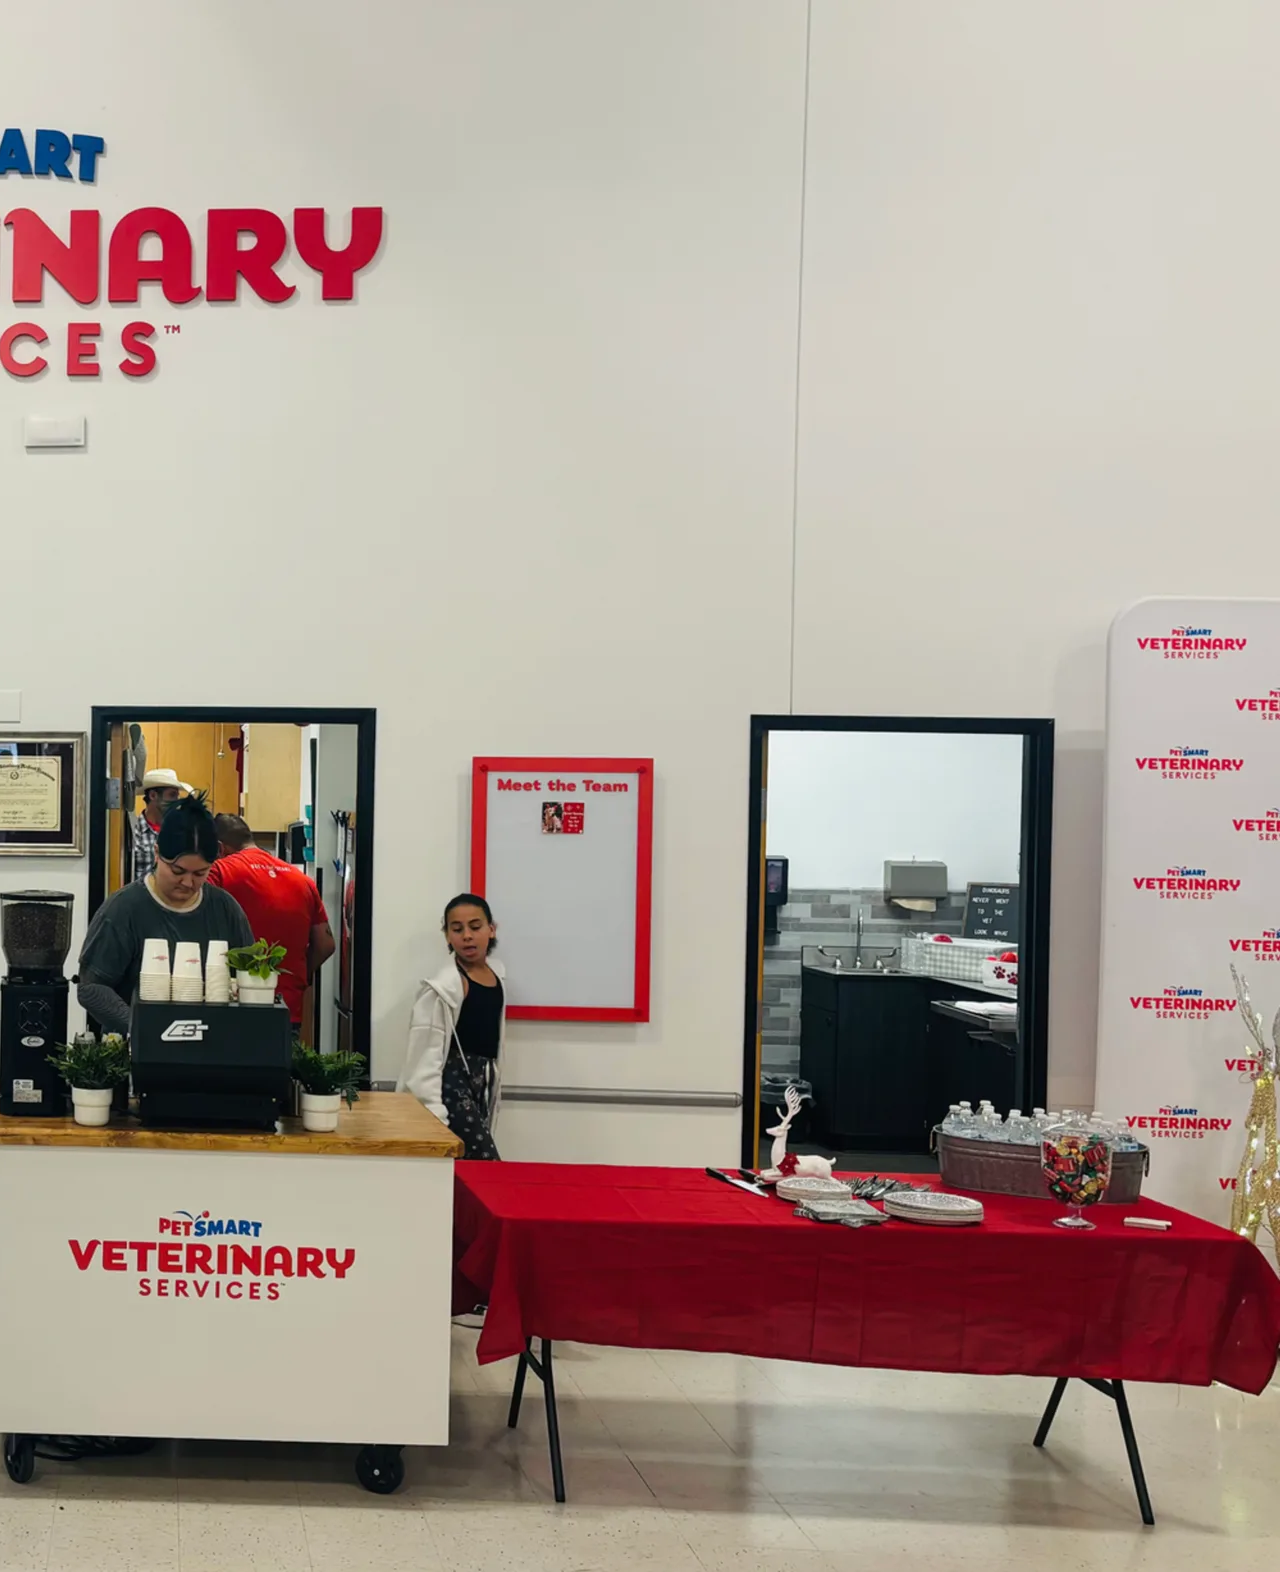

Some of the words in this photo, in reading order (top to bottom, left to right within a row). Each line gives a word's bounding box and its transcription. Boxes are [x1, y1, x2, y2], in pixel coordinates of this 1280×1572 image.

[1137, 637, 1247, 651] VETERINARY
[1135, 757, 1244, 771] VETERINARY
[497, 778, 541, 792] Meet
[547, 779, 577, 792] the
[582, 779, 629, 793] Team
[1133, 876, 1241, 891] VETERINARY
[1129, 996, 1237, 1011] VETERINARY
[1125, 1116, 1232, 1131] VETERINARY
[158, 1216, 263, 1238] PETSMART
[67, 1238, 356, 1280] VETERINARY
